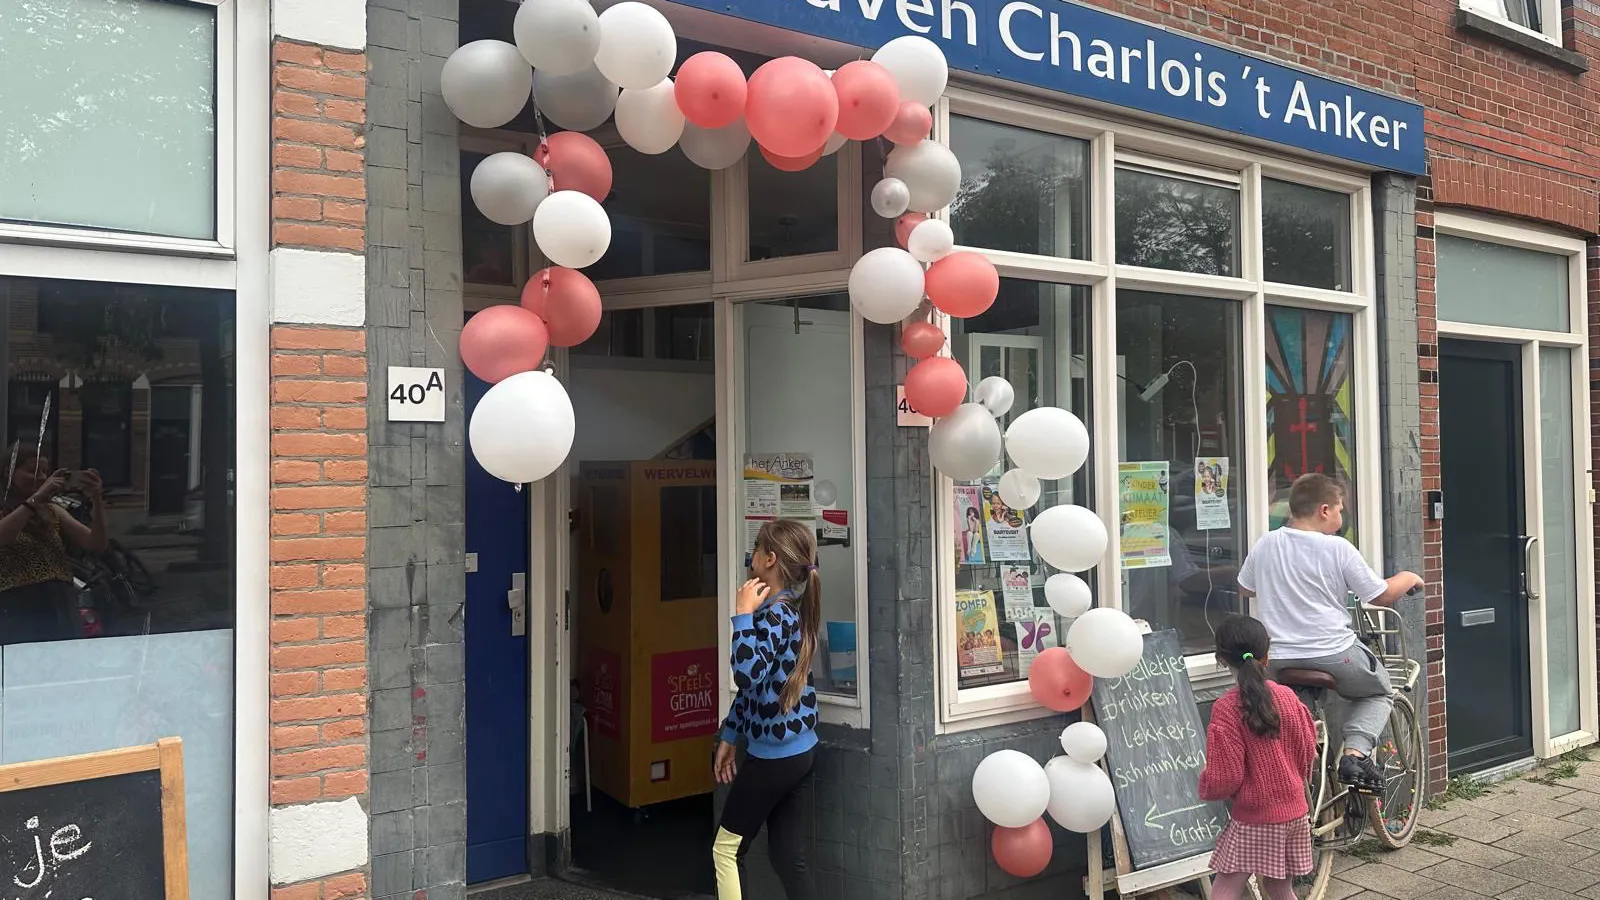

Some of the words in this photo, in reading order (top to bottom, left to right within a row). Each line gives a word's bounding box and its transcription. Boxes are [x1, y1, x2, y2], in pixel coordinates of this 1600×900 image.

[804, 0, 977, 46] ven
[998, 1, 1227, 107] Charlois
[1241, 66, 1272, 119] 't
[1283, 80, 1408, 151] Anker
[670, 690, 712, 711] GEMAK
[1102, 689, 1178, 721] Drinken
[1114, 749, 1207, 788] Schminken
[1169, 816, 1222, 846] Gratis
[13, 816, 92, 888] je
